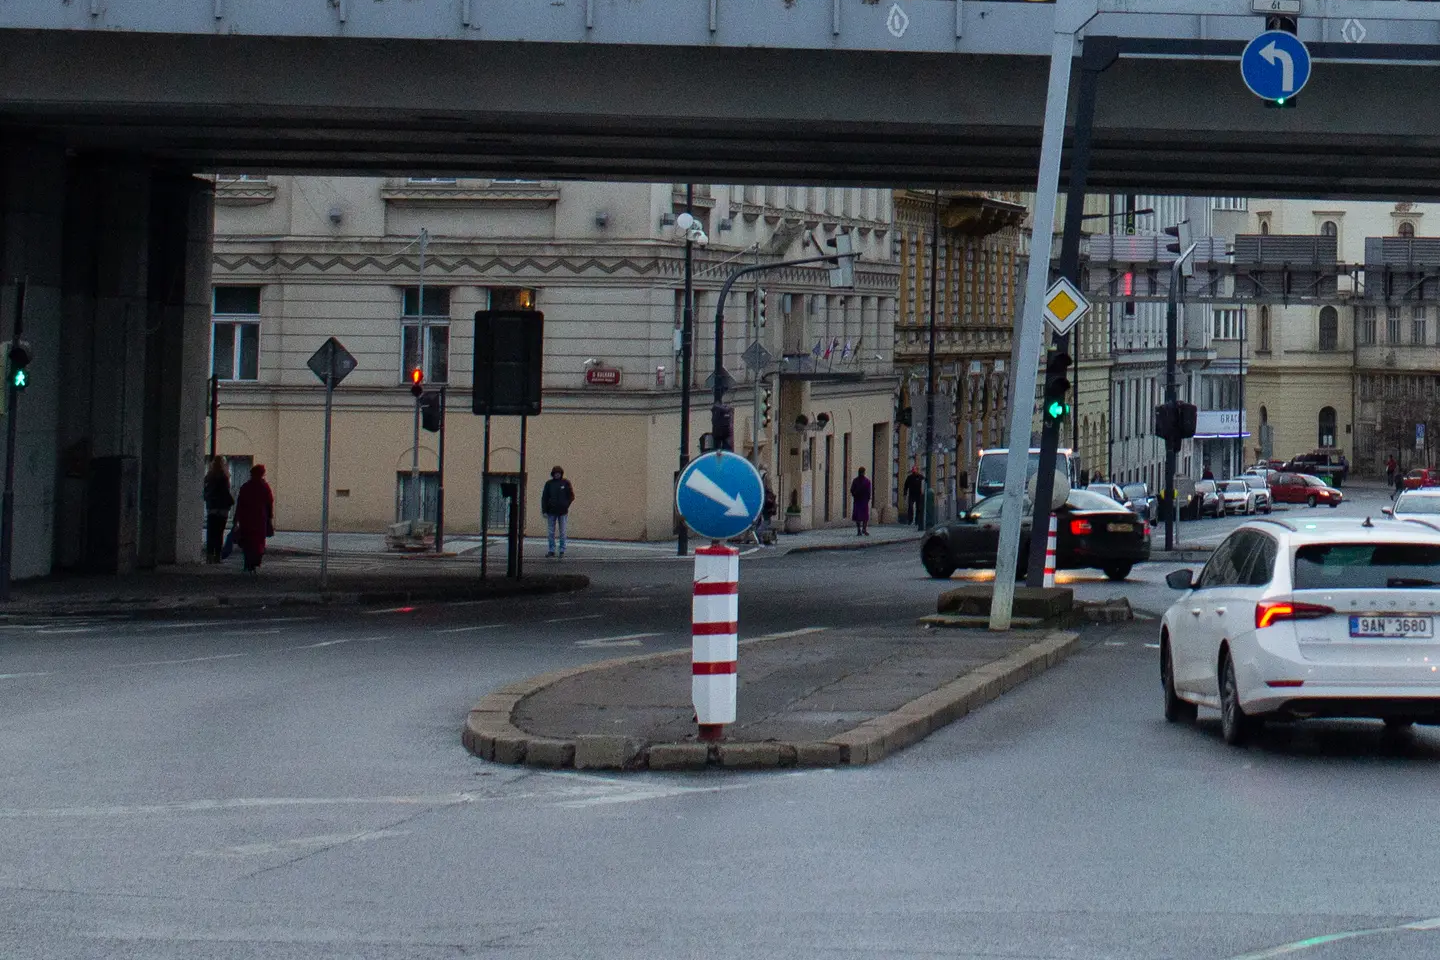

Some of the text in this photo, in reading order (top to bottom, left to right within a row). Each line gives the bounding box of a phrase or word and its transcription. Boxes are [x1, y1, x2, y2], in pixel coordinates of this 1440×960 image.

[1271, 0, 1280, 10] 6t
[1361, 618, 1427, 633] 9AN 3680
